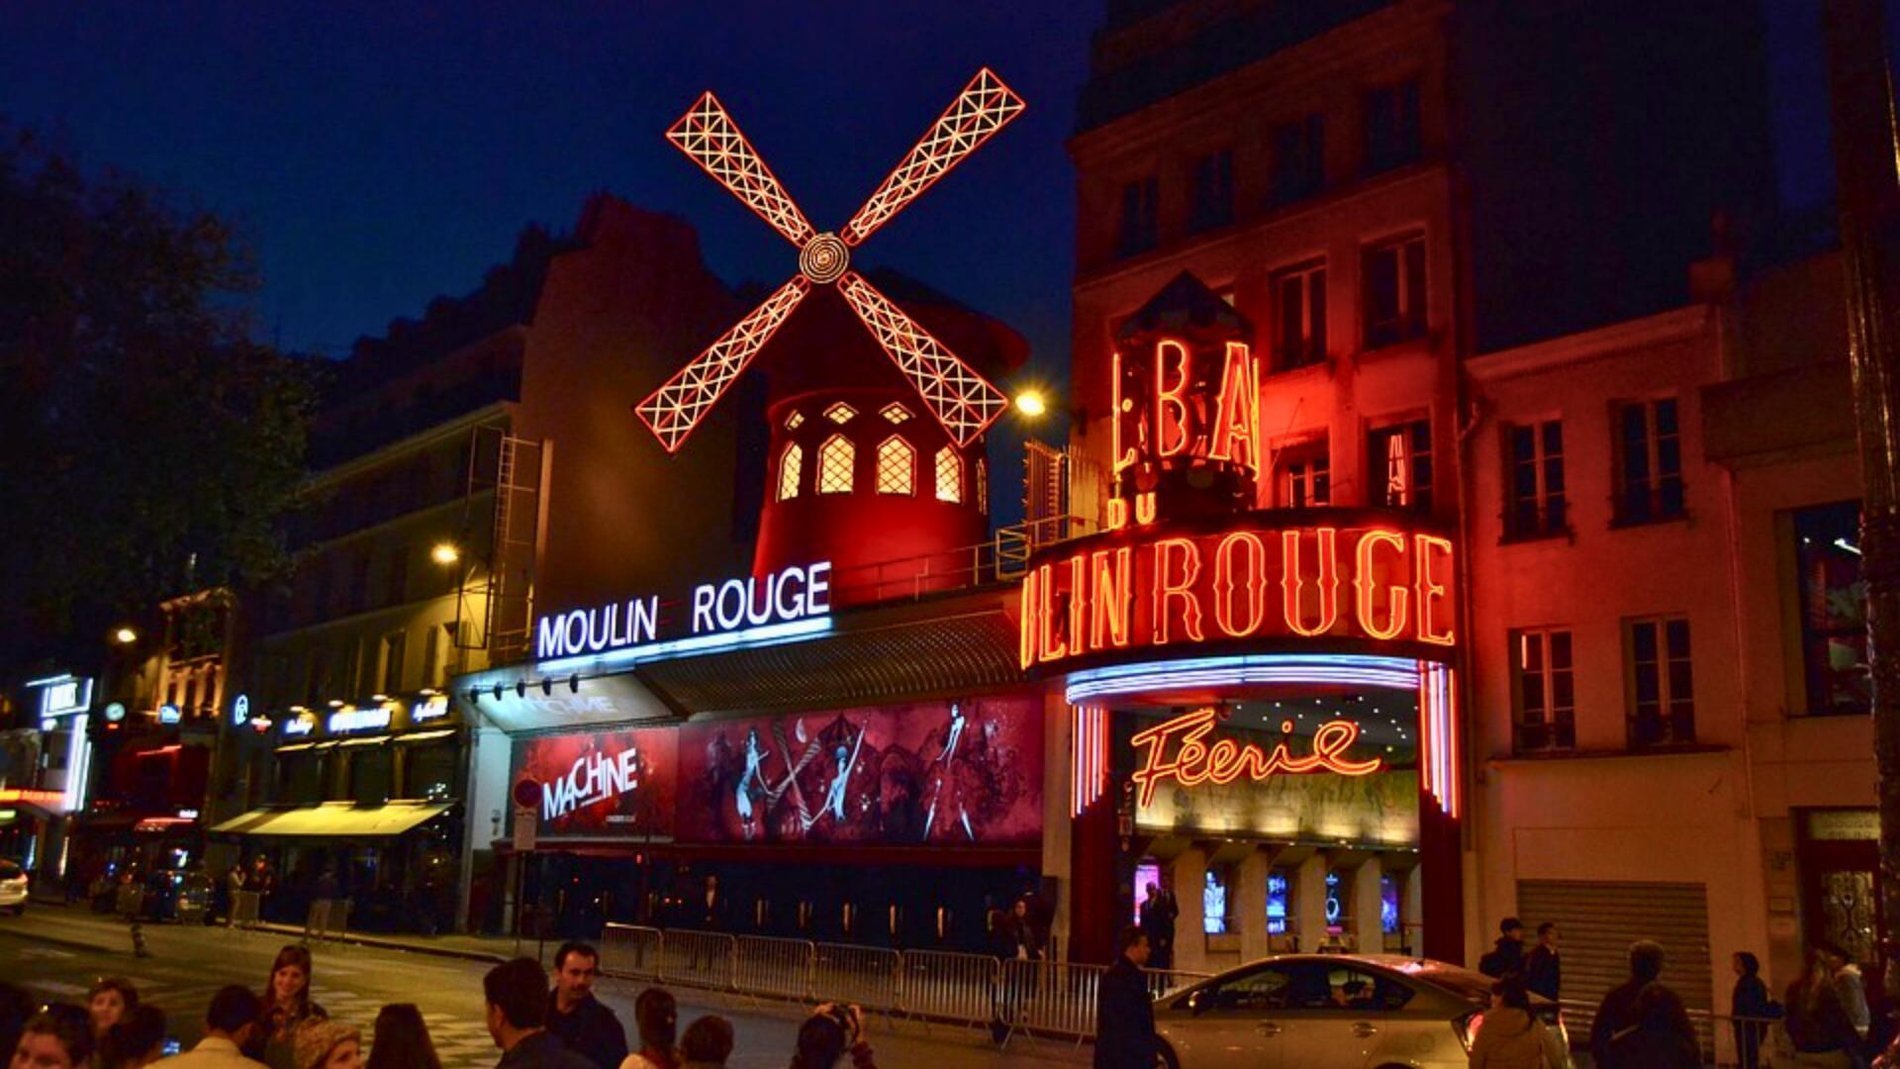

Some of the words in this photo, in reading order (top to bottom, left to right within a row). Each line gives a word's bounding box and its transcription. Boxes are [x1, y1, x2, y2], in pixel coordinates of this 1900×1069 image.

[1107, 491, 1156, 530] DU
[538, 595, 659, 658] MOULIN
[692, 561, 833, 632] ROUGE
[1153, 527, 1456, 647] ROUGE
[542, 747, 639, 822] MACHINE
